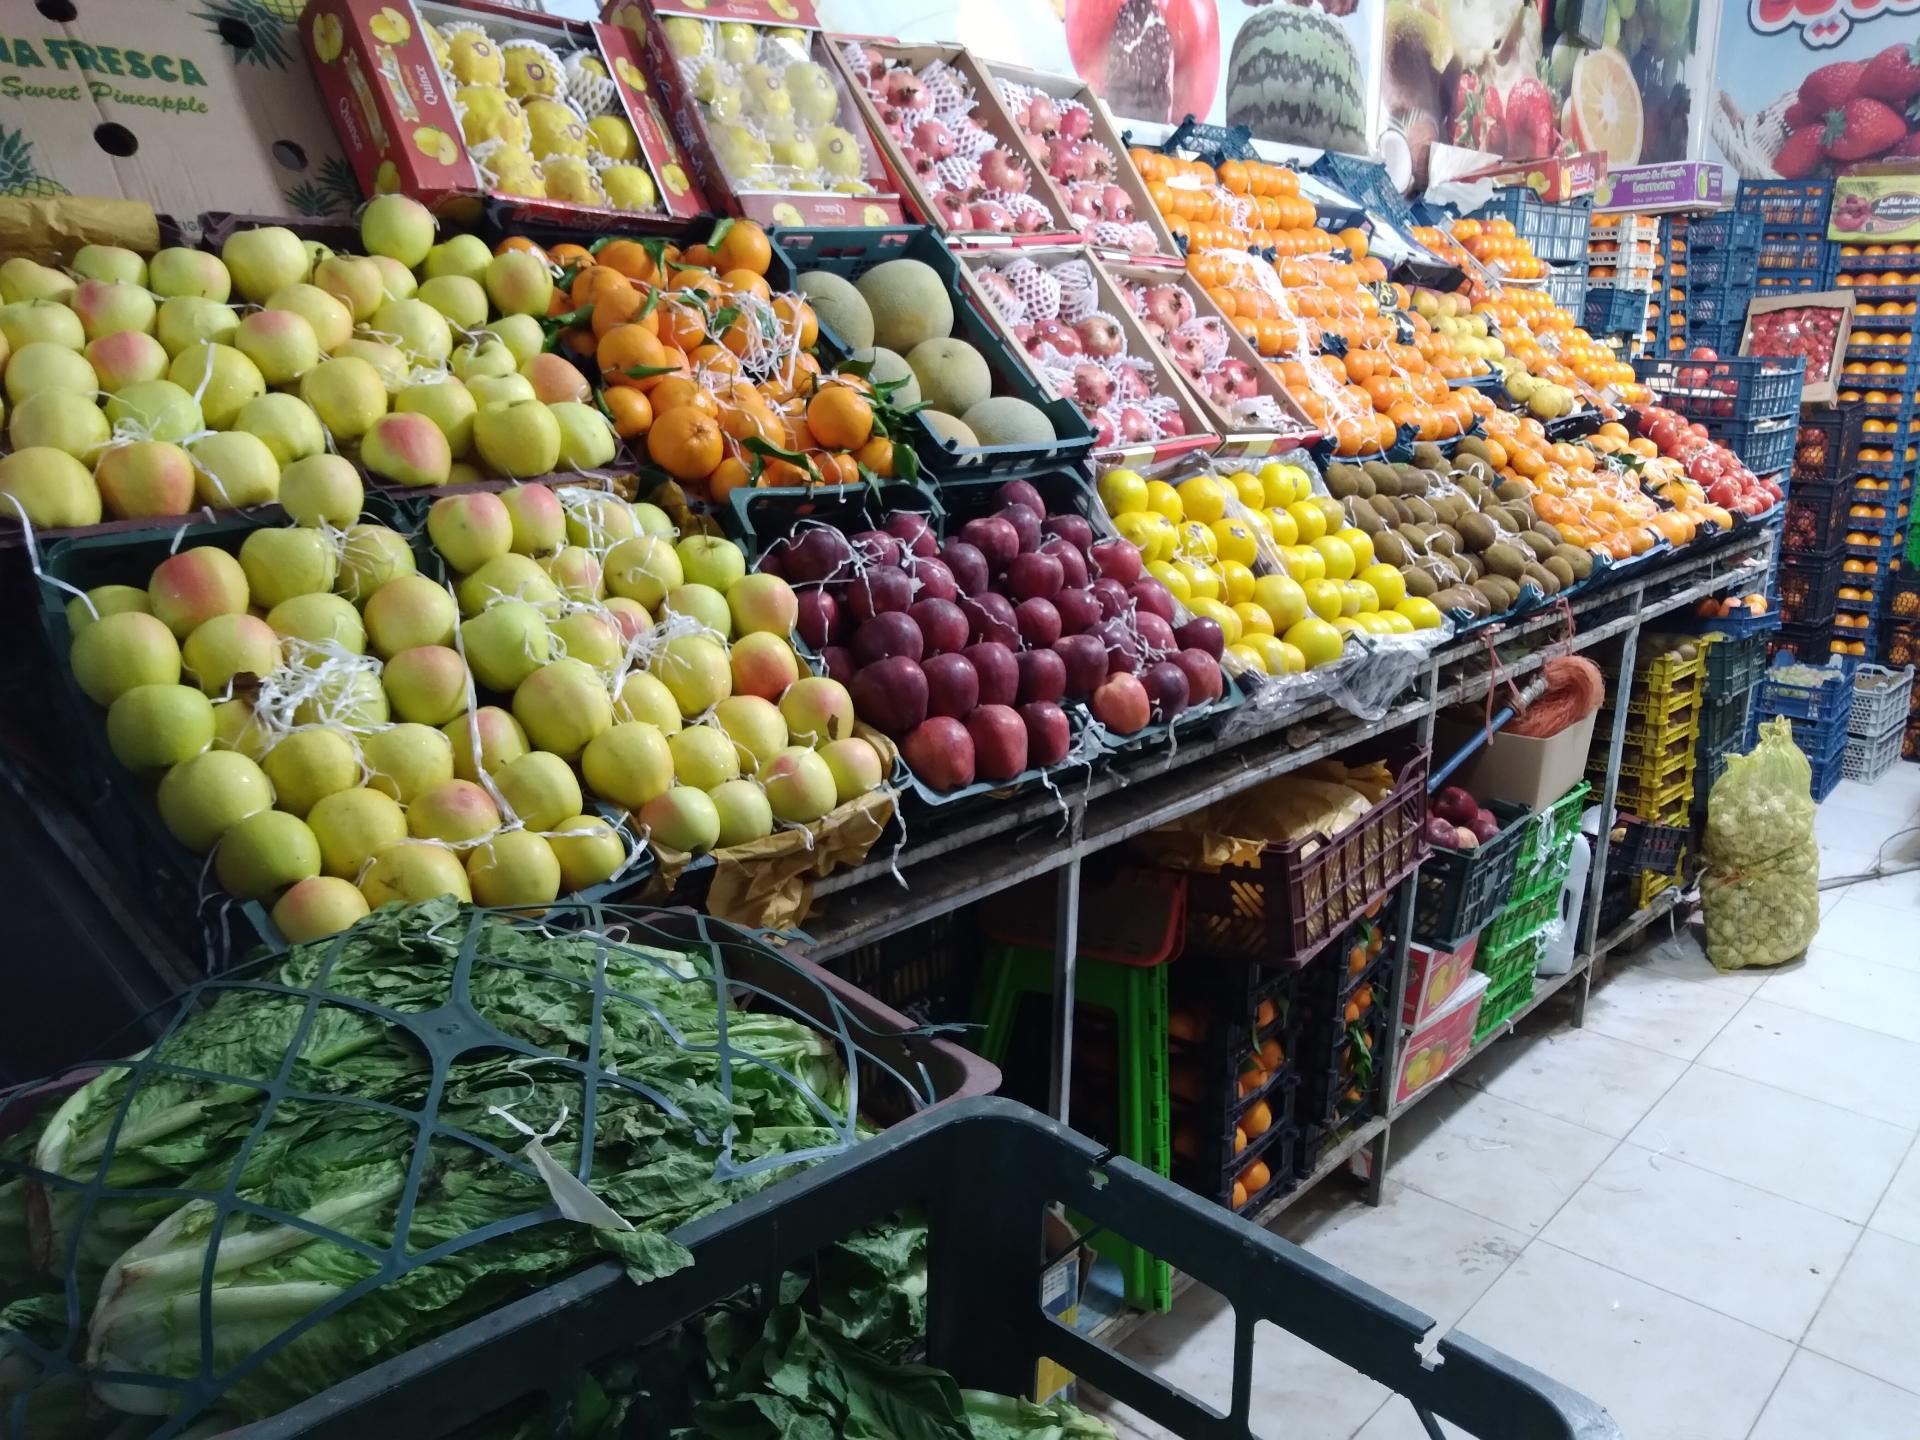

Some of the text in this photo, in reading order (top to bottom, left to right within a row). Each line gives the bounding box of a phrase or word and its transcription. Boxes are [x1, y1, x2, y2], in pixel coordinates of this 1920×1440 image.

[43, 38, 208, 86] FRESCA
[1, 75, 209, 115] Sweet Pineapple
[416, 64, 438, 105] Quince
[340, 97, 362, 152] Quince
[1632, 179, 1676, 194] lemon
